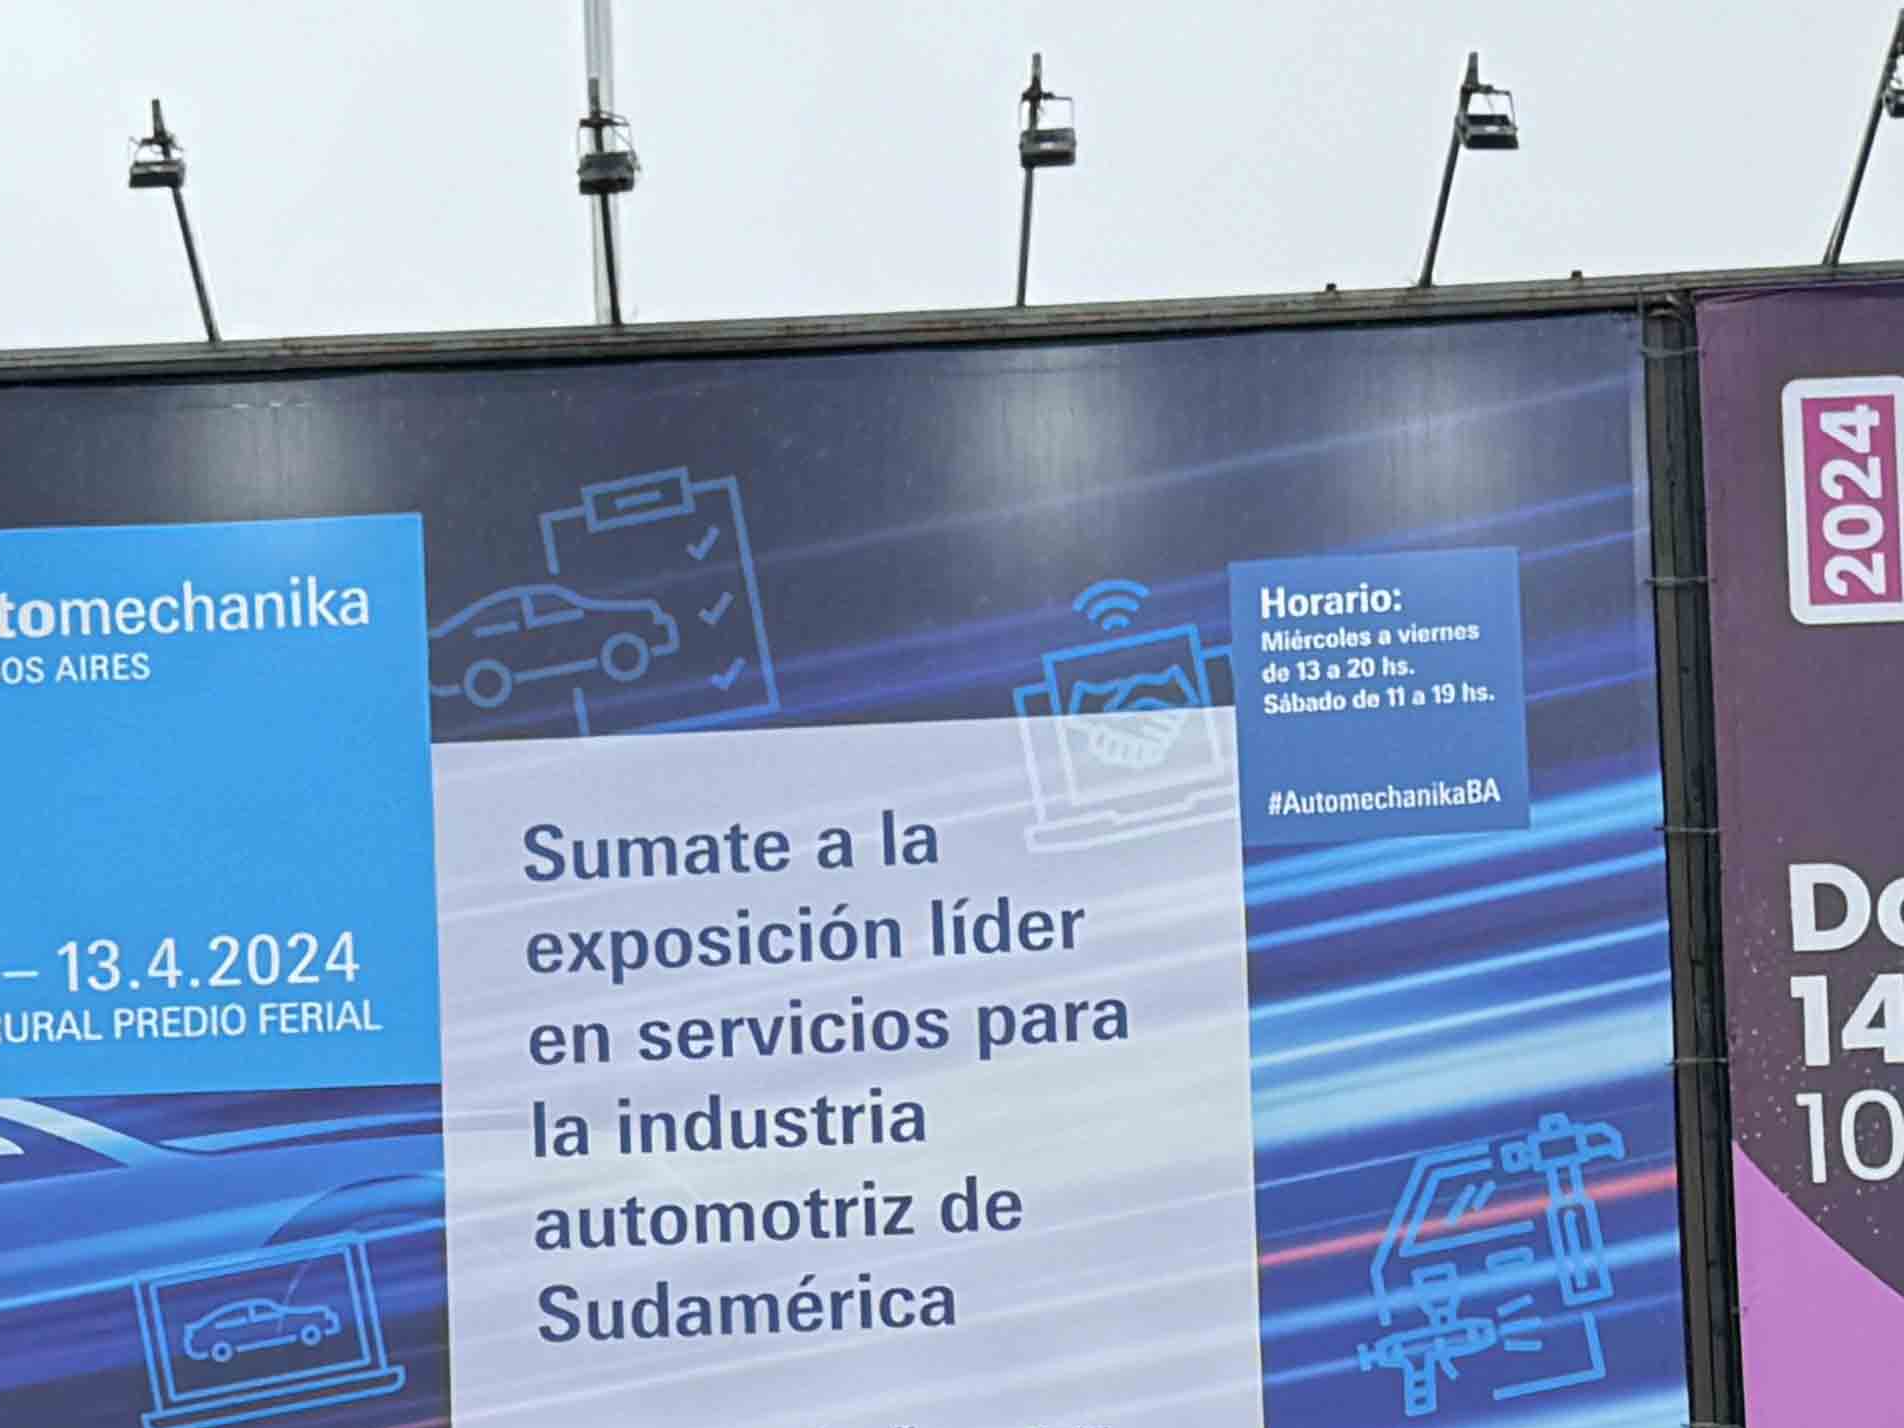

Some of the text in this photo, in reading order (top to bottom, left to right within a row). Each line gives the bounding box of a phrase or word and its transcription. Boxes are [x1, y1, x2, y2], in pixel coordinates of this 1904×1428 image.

[1824, 405, 1889, 598] 2024
[1260, 582, 1403, 619] Horario:
[55, 653, 151, 681] AIRES
[1261, 622, 1480, 652] Miércoles a viernes
[1263, 657, 1416, 684] de 13 a 20 hs.
[1264, 682, 1495, 715] Sábado de 11 a 19 hs.
[1268, 777, 1501, 817] #AutomechanikaBA
[523, 810, 940, 882] Sumate a la
[56, 930, 361, 993] 13.4.2024
[525, 896, 1086, 985] exposición líder
[113, 1003, 247, 1039] PREDIO
[258, 999, 383, 1035] FERIAL
[528, 997, 1130, 1065] en servicios para
[532, 1087, 927, 1158] la industria
[534, 1175, 1024, 1252] automotriz de
[537, 1273, 957, 1344] Sudamérica
